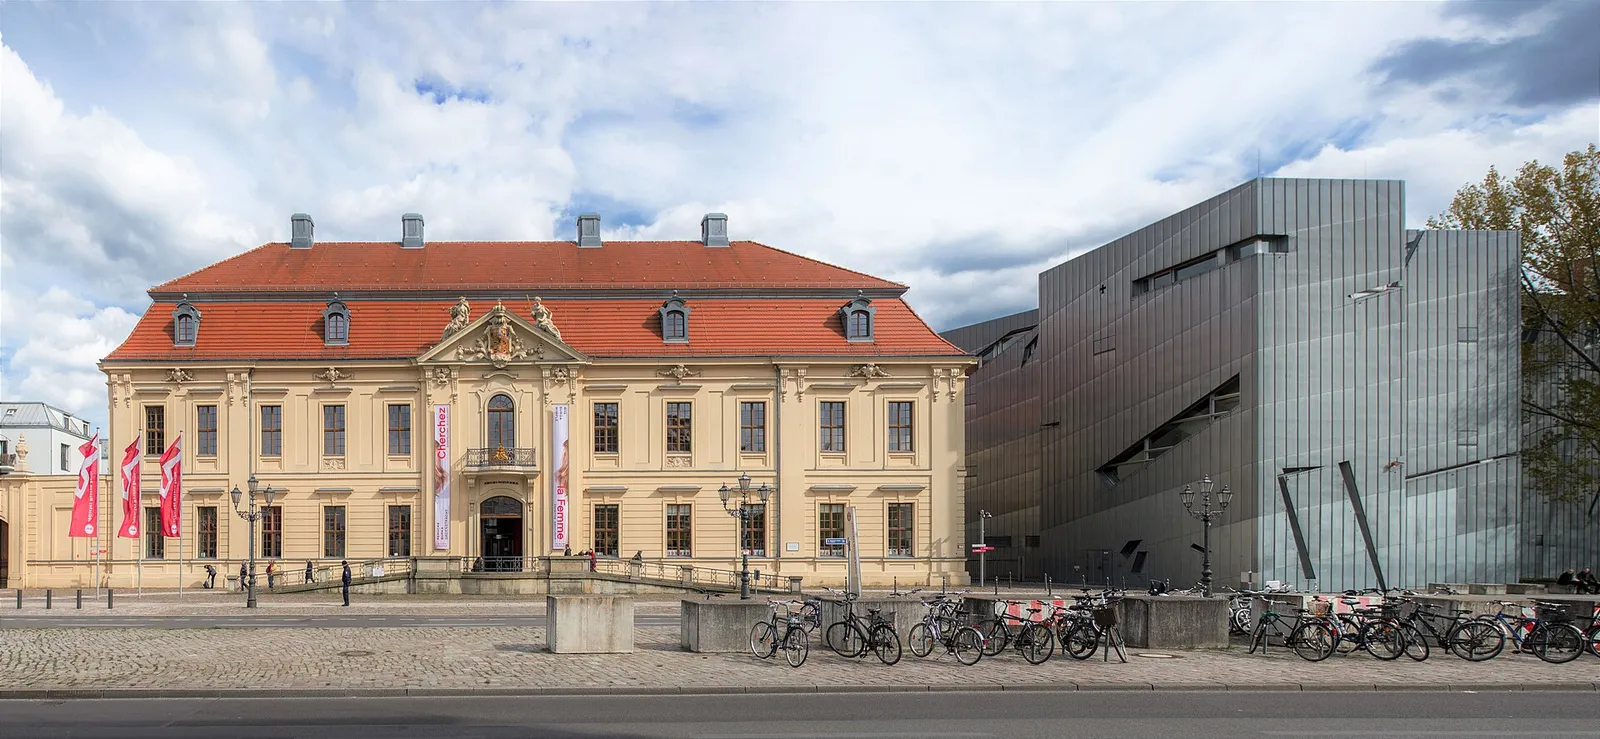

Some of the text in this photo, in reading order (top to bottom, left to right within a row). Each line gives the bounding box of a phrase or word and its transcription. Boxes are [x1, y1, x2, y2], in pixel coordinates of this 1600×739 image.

[437, 407, 446, 460] Cherchez
[557, 485, 566, 494] la
[557, 499, 566, 540] Femme
